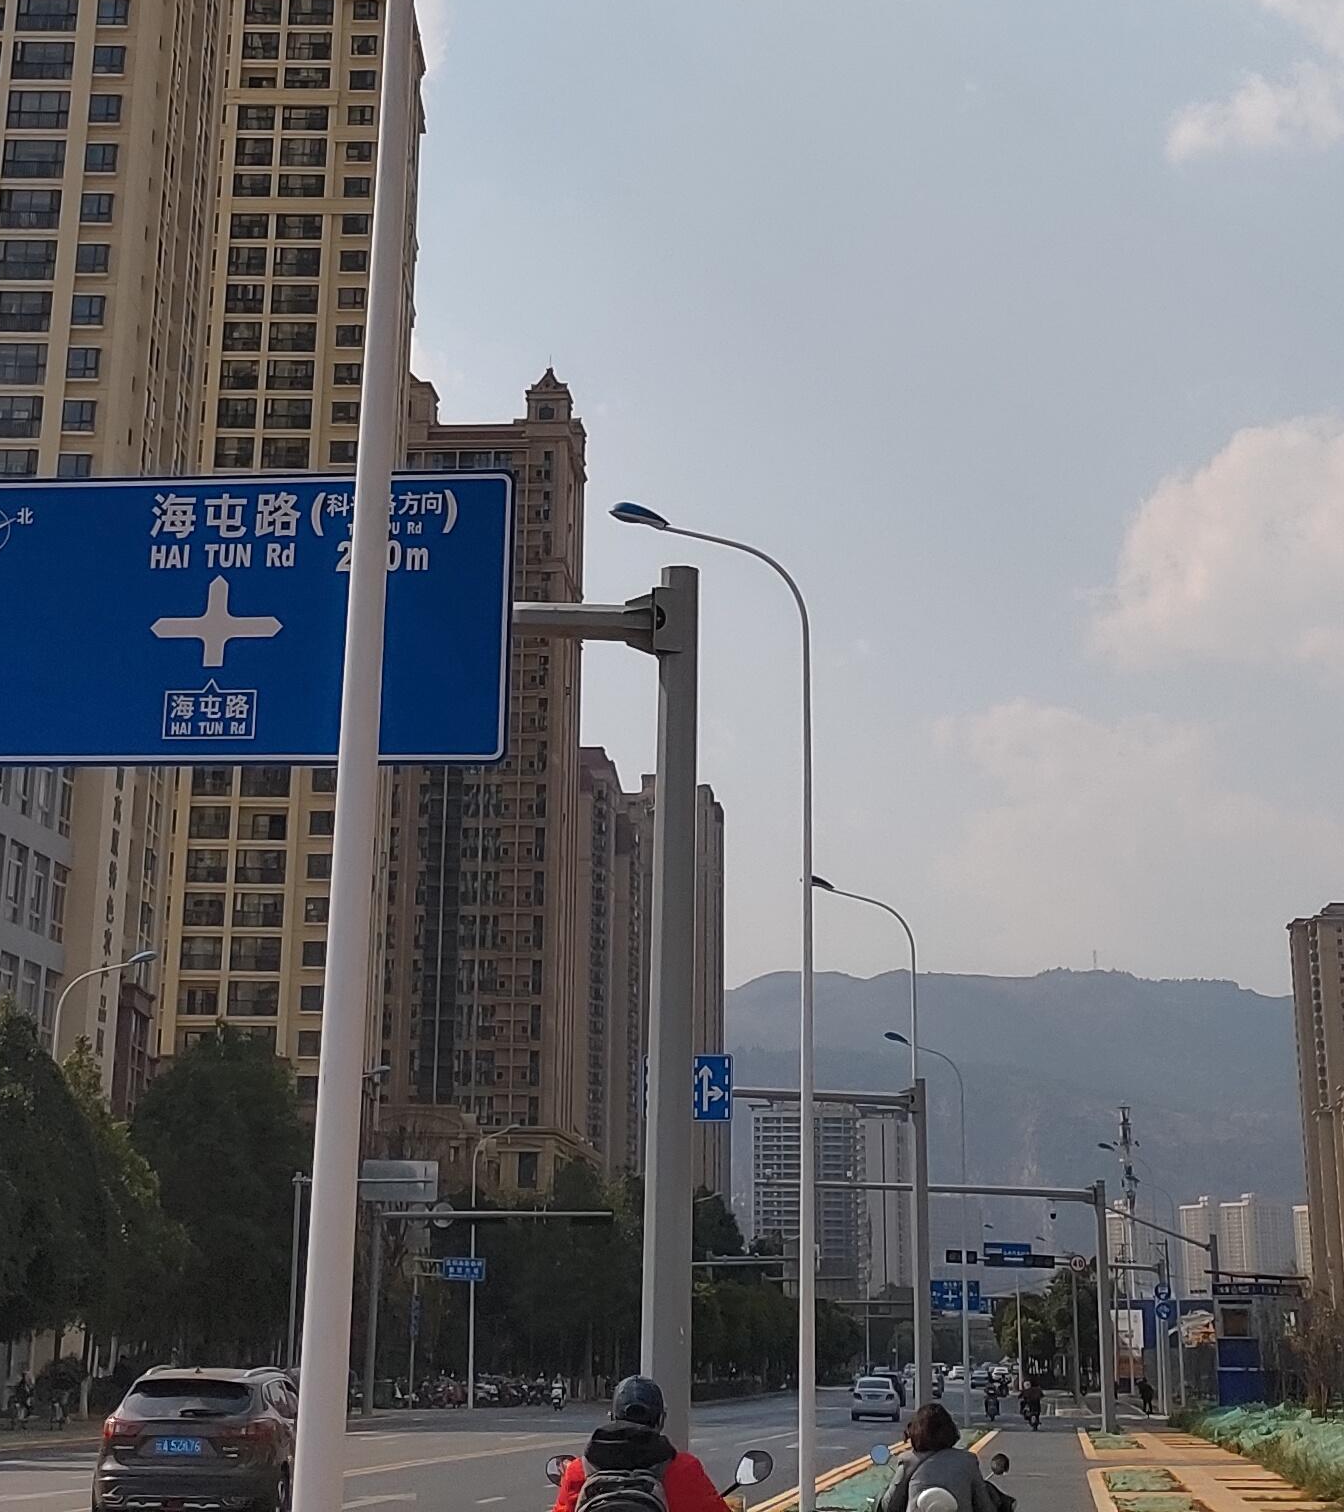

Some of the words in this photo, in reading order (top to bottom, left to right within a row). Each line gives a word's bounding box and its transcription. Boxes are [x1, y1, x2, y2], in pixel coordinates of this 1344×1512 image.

[17, 507, 34, 524] 北
[150, 492, 301, 539] 海屯路
[311, 489, 457, 536] (科方向)
[407, 521, 423, 535] Rd
[150, 544, 190, 569] HAI
[205, 543, 252, 568] TUN
[266, 542, 295, 567] Rd
[170, 694, 249, 719] 海屯路
[171, 721, 192, 735] HAI
[198, 721, 224, 735] TUN
[230, 721, 246, 735] Rd
[1072, 1259, 1084, 1268] 40
